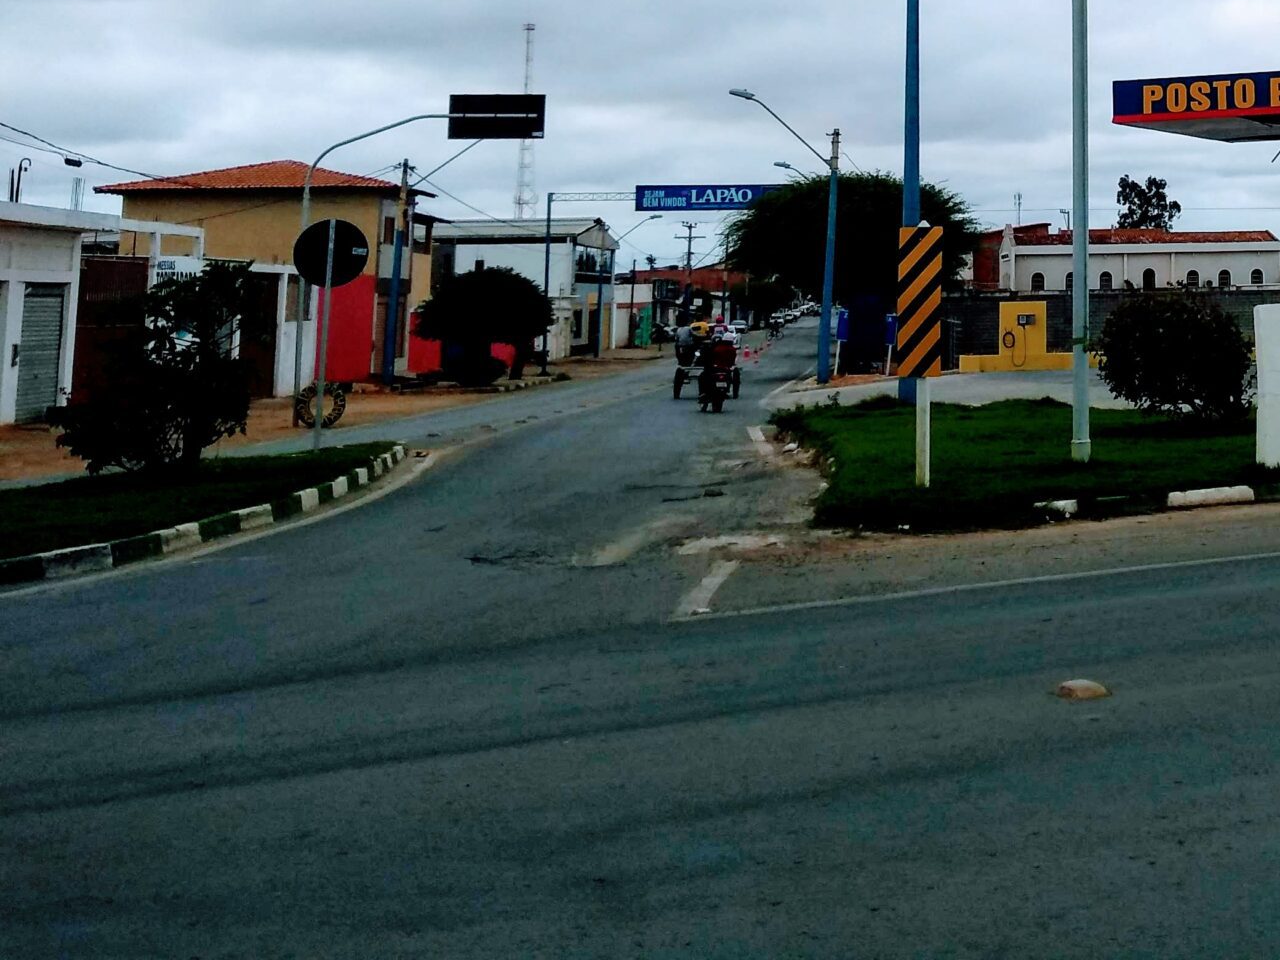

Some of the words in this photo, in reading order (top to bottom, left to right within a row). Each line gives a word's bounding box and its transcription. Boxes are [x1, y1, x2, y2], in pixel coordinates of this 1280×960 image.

[1142, 78, 1256, 115] POSTO
[644, 190, 665, 198] SEJAM
[690, 187, 753, 204] LAPÃO
[643, 198, 659, 207] BEM
[660, 197, 687, 207] VINDOS
